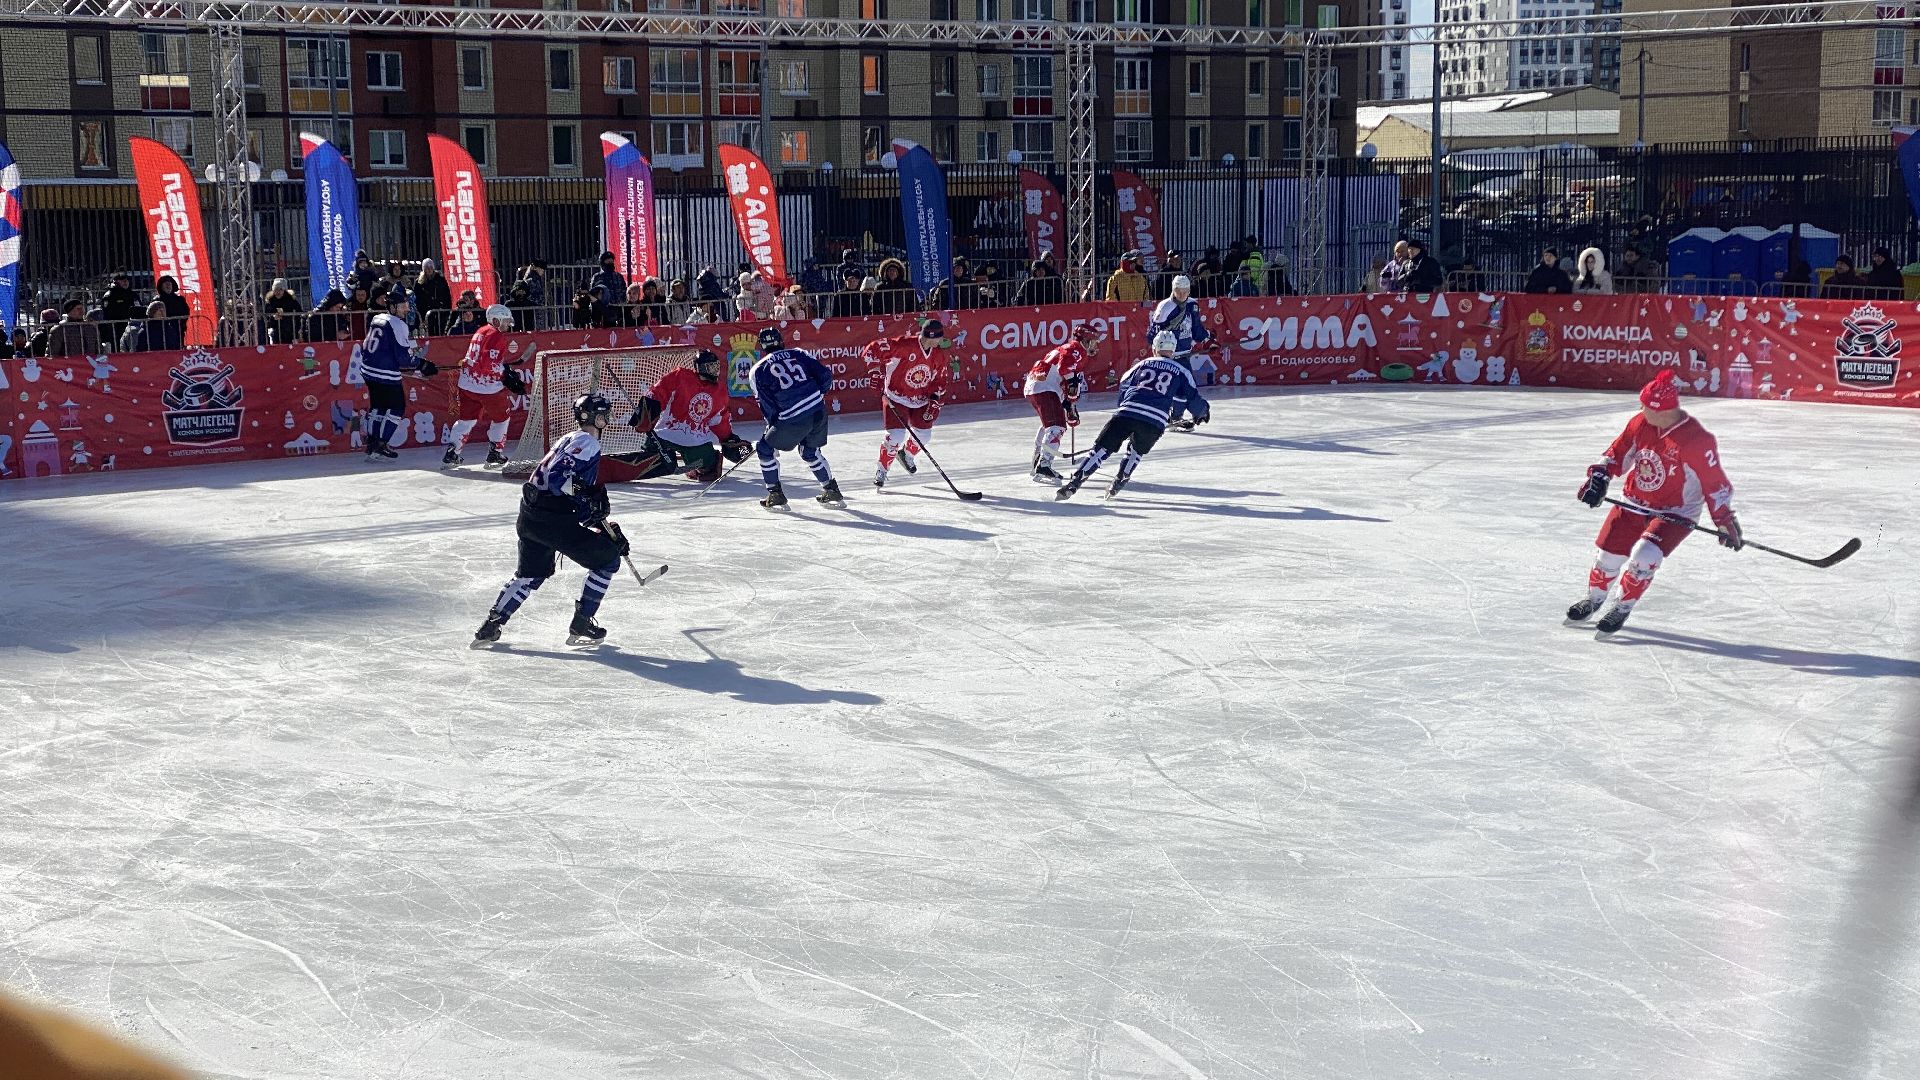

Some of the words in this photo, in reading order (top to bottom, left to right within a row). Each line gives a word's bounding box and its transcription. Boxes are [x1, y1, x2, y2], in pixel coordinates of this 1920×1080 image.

[1239, 313, 1378, 350] ЗИМА
[1563, 325, 1653, 343] КОМАНДА
[1271, 355, 1356, 366] Подмосковье
[1563, 348, 1681, 366] ГУБЕРНАТОРА
[770, 358, 808, 390] 85
[1841, 362, 1862, 372] МАТЧ
[1863, 363, 1893, 374] ЛЕГЕНД
[829, 378, 847, 391] ГО
[1137, 368, 1173, 395] 28
[173, 416, 199, 430] МАТЧ
[200, 414, 236, 428] ЛЕГЕНД
